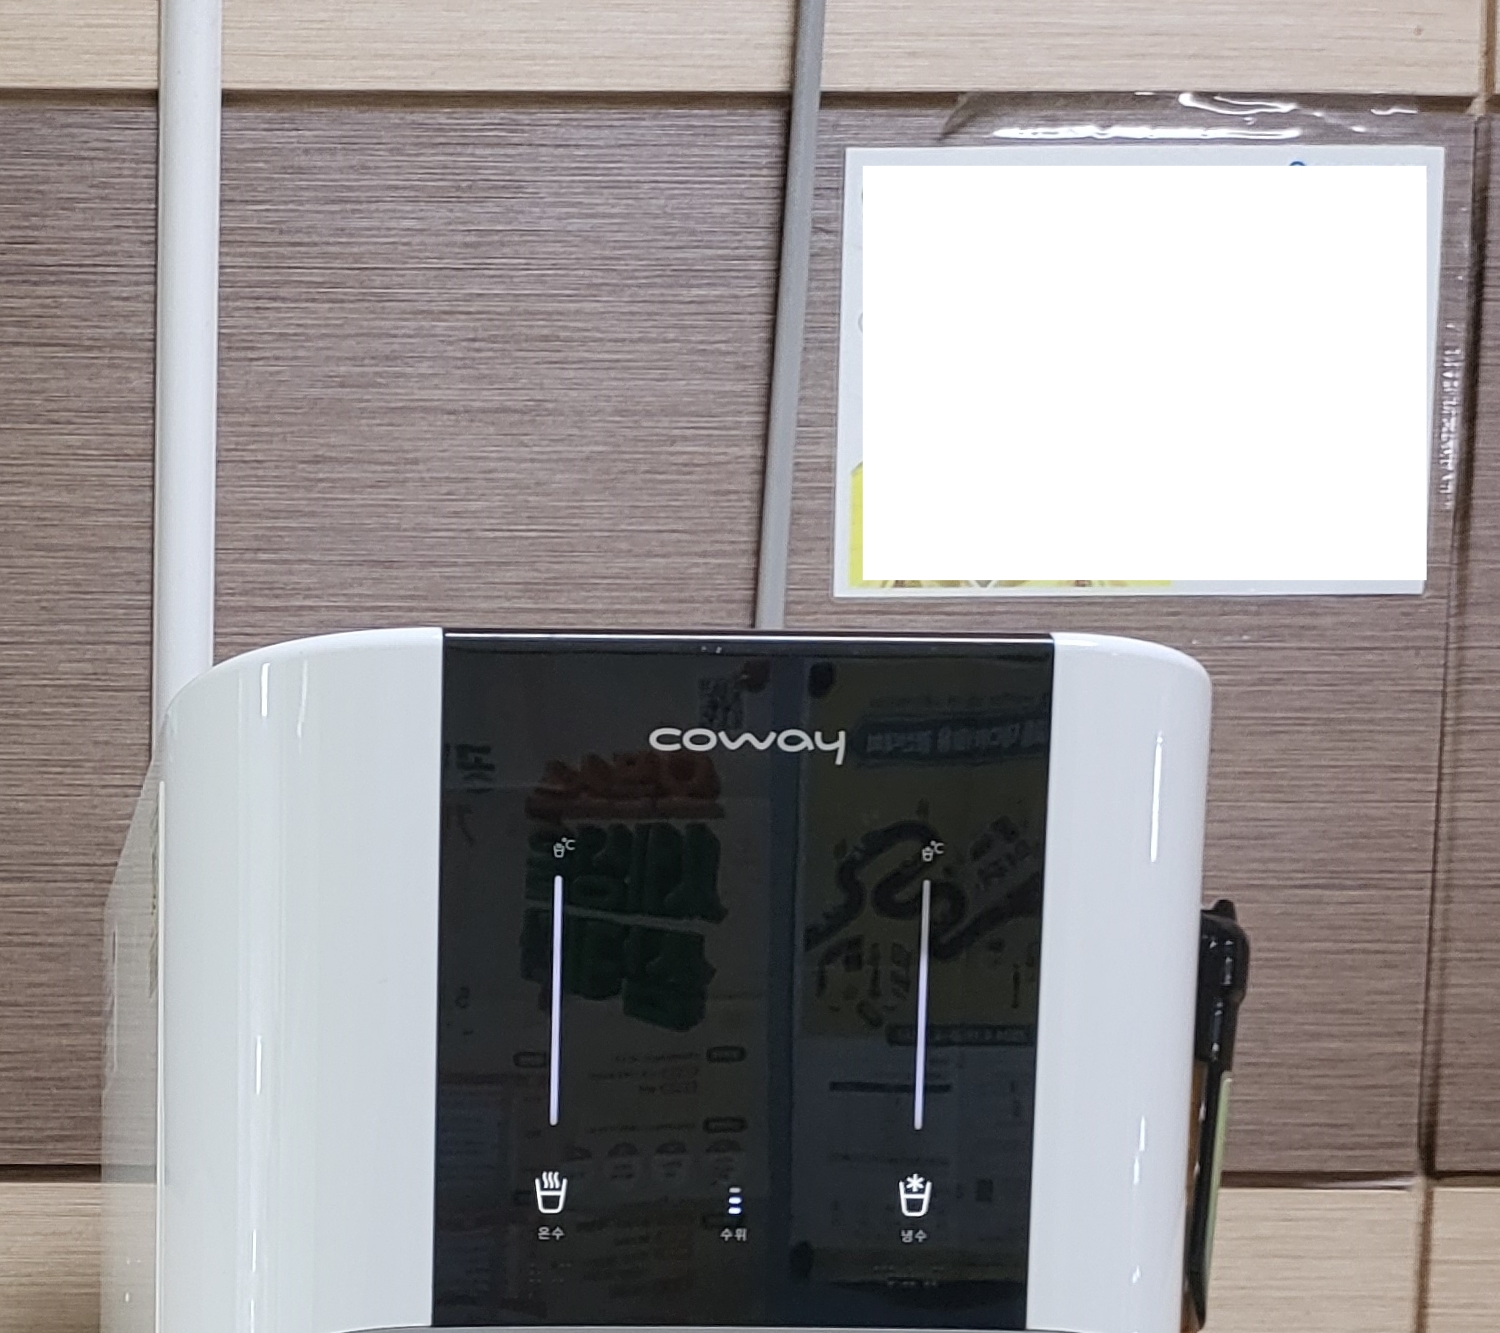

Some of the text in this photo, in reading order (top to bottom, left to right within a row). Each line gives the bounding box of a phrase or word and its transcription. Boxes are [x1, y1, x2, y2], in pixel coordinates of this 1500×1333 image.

[648, 727, 847, 765] coway
[537, 1226, 565, 1241] 온수
[720, 1228, 748, 1243] 수위
[900, 1229, 928, 1243] 냉수
